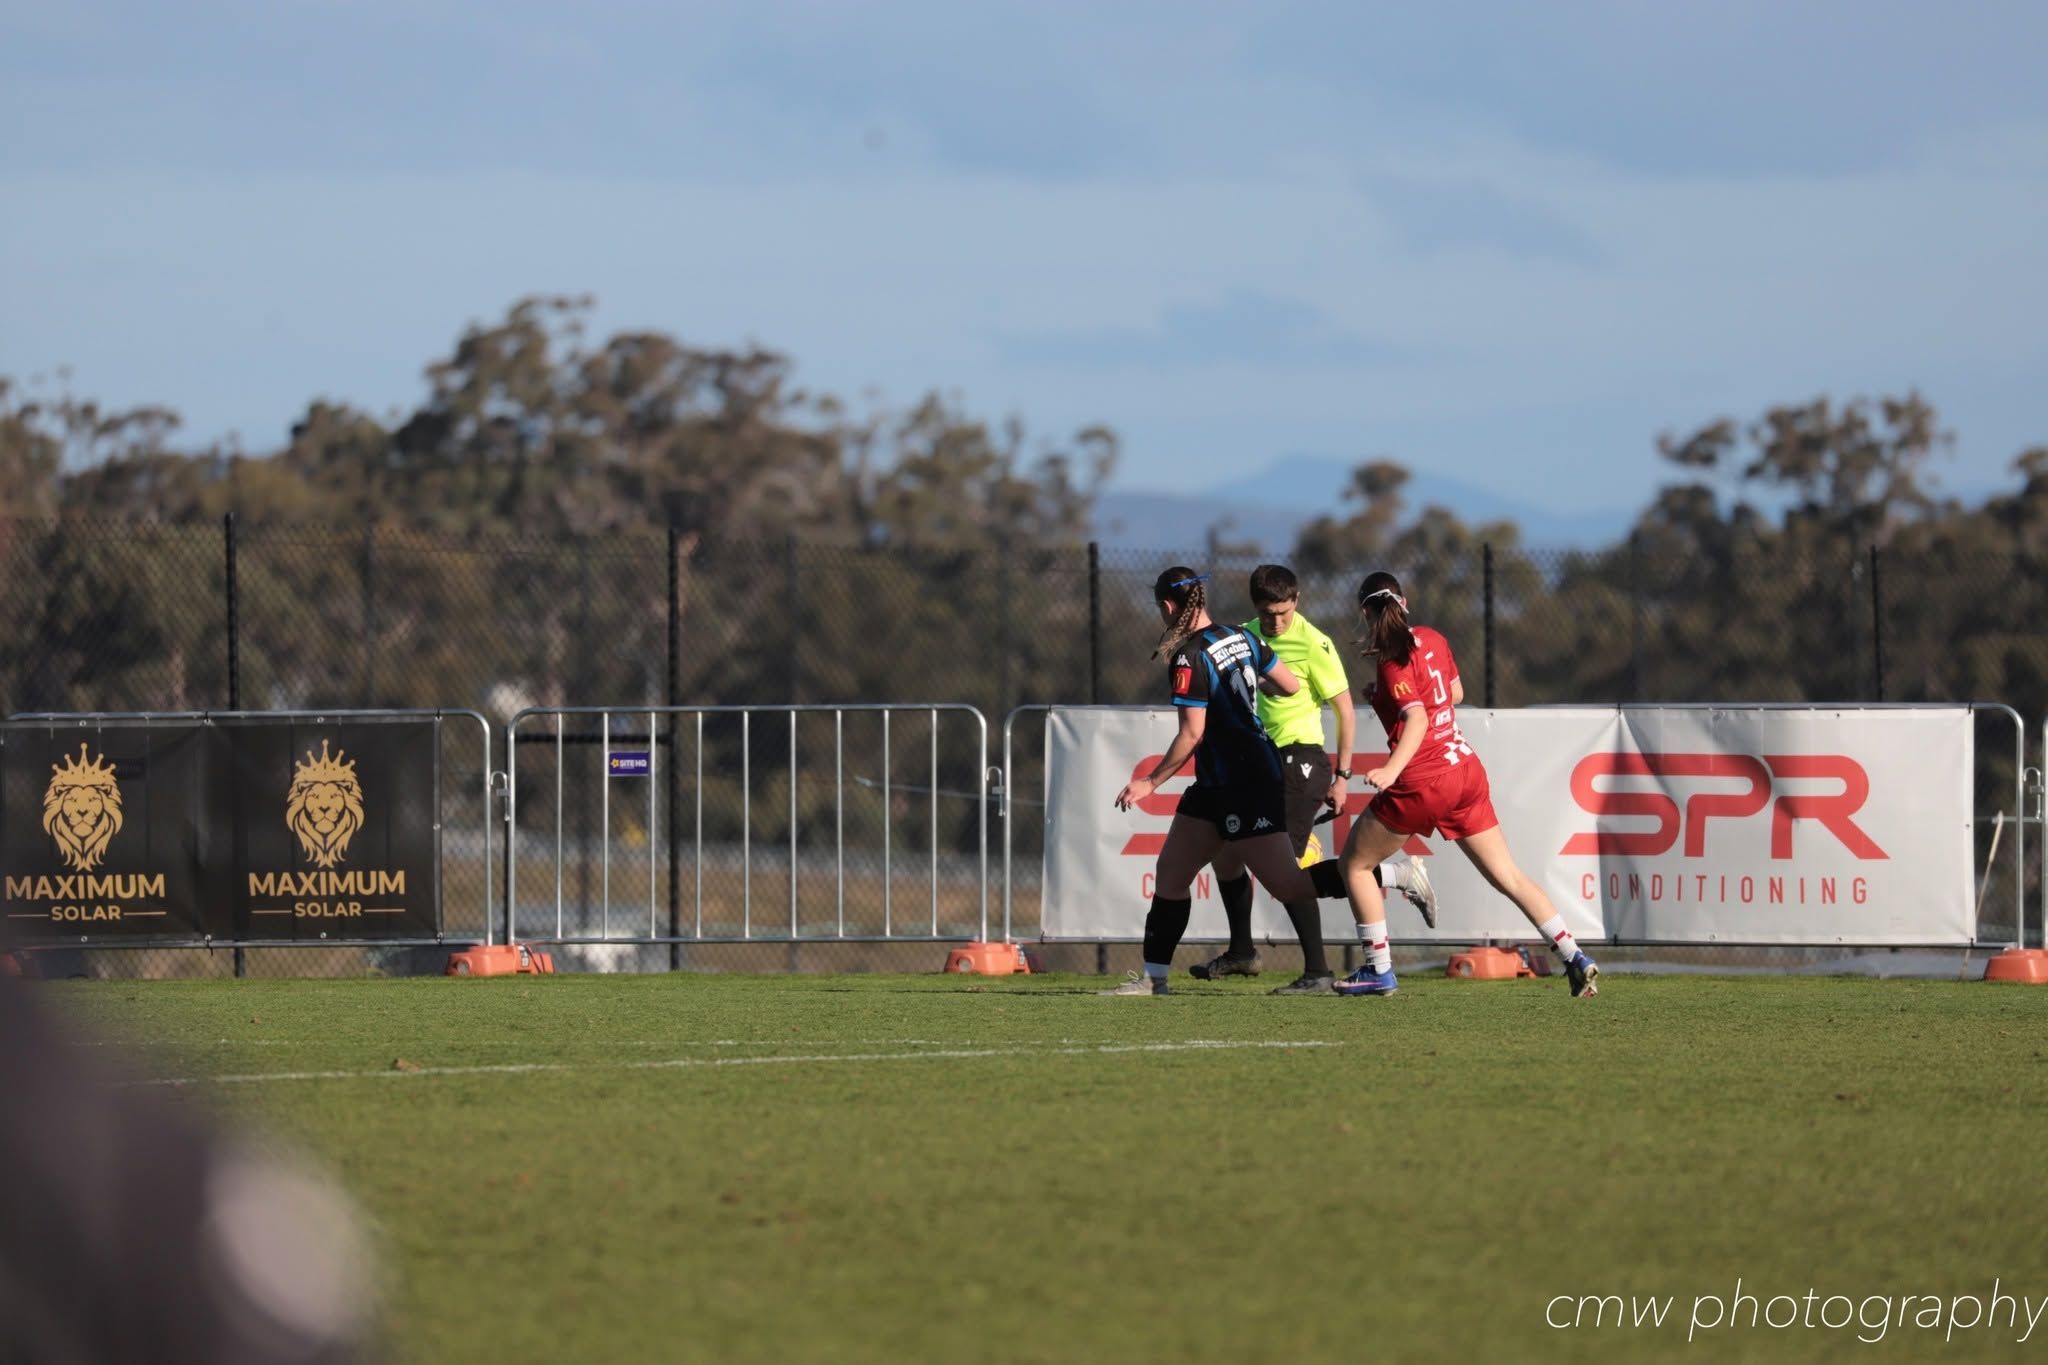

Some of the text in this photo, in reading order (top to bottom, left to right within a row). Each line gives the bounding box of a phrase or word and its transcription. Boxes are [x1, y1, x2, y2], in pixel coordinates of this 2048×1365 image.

[1212, 643, 1250, 663] Kitchen
[1424, 651, 1447, 705] 5
[619, 759, 648, 768] SITE HQ
[1559, 752, 1890, 860] SPR
[5, 872, 166, 900] MAXIMUM
[248, 870, 406, 897] MAXIMUM
[1582, 873, 1868, 905] CONDITIONING
[51, 904, 122, 921] SOLAR
[294, 901, 362, 918] SOLAR
